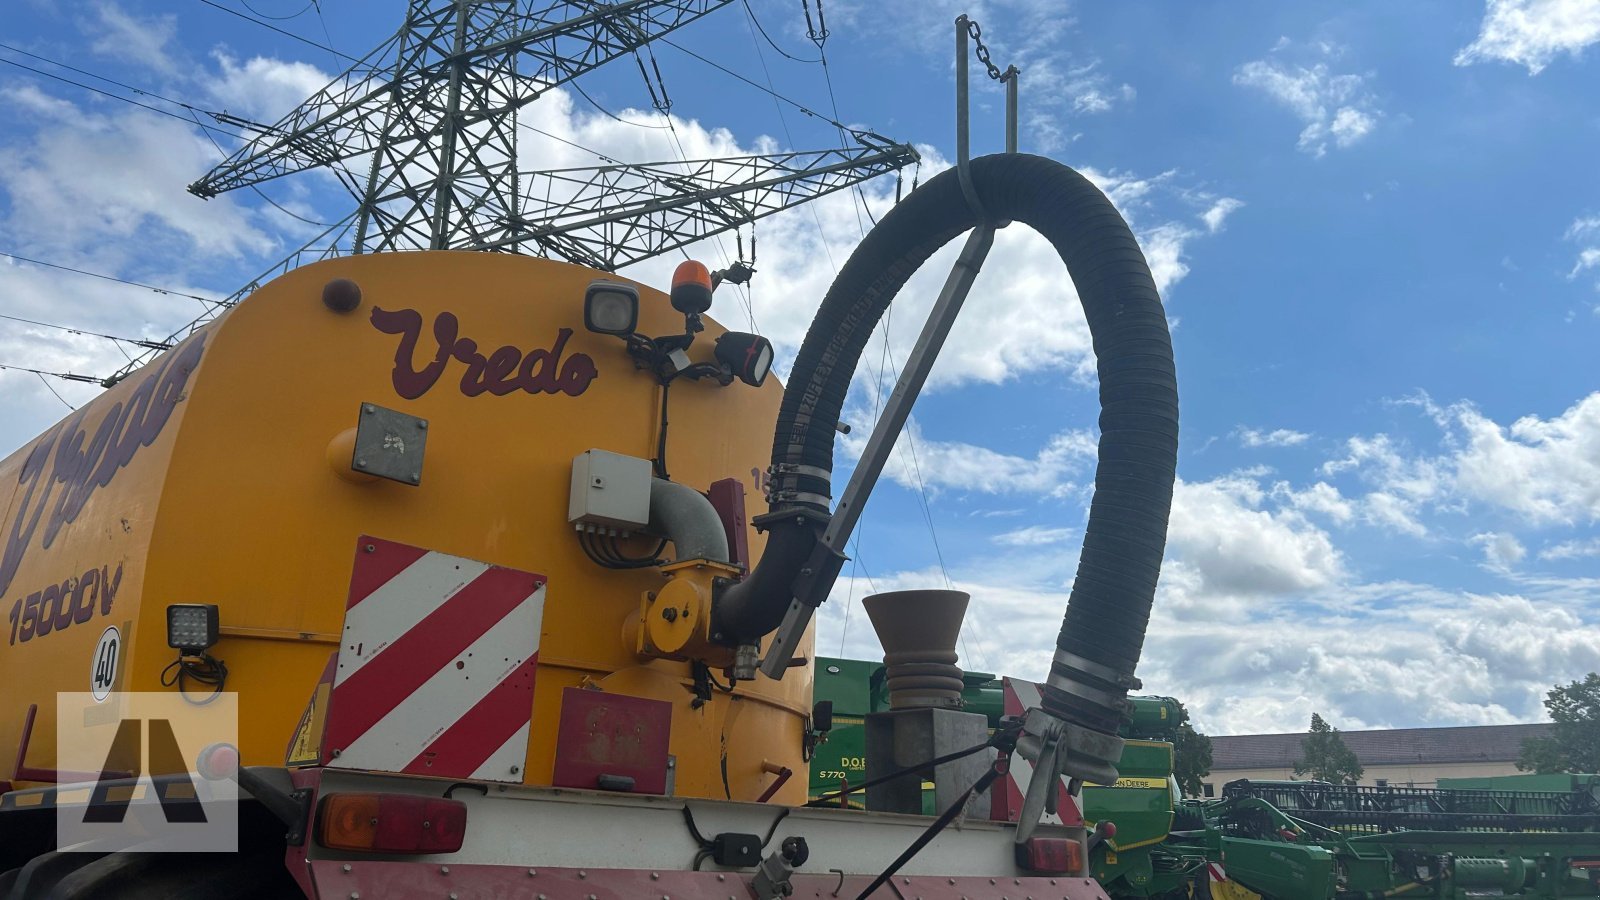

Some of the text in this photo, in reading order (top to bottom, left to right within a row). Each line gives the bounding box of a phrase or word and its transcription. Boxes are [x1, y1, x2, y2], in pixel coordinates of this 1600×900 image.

[370, 306, 598, 399] Vredo
[10, 561, 123, 647] 15000V
[95, 638, 117, 688] 40
[1126, 779, 1149, 788] DEERE
